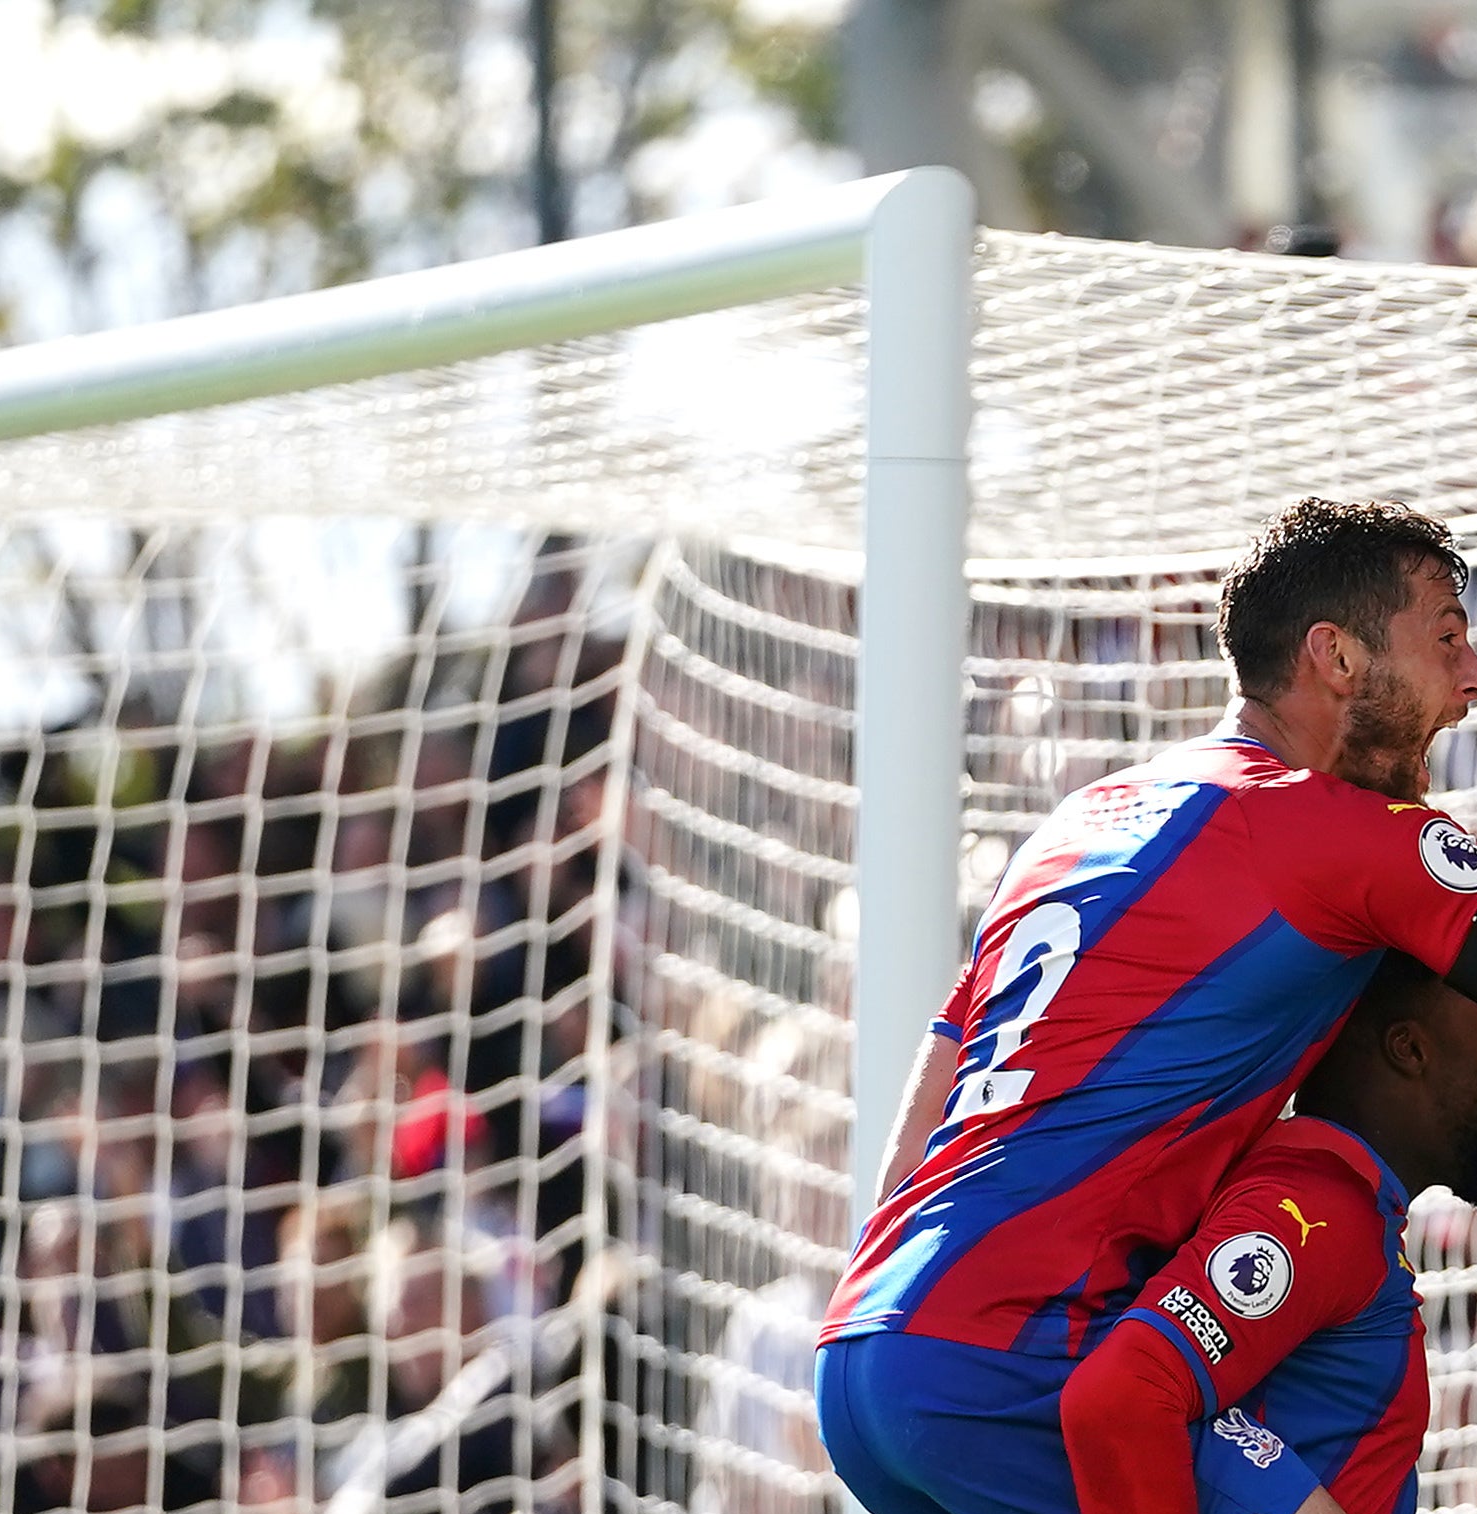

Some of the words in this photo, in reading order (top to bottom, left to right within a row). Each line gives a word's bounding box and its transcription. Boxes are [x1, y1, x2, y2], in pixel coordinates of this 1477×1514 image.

[1158, 1295, 1186, 1314] for
[1180, 1310, 1222, 1365] racism
[1166, 1285, 1194, 1307] No
[1190, 1303, 1228, 1349] room
